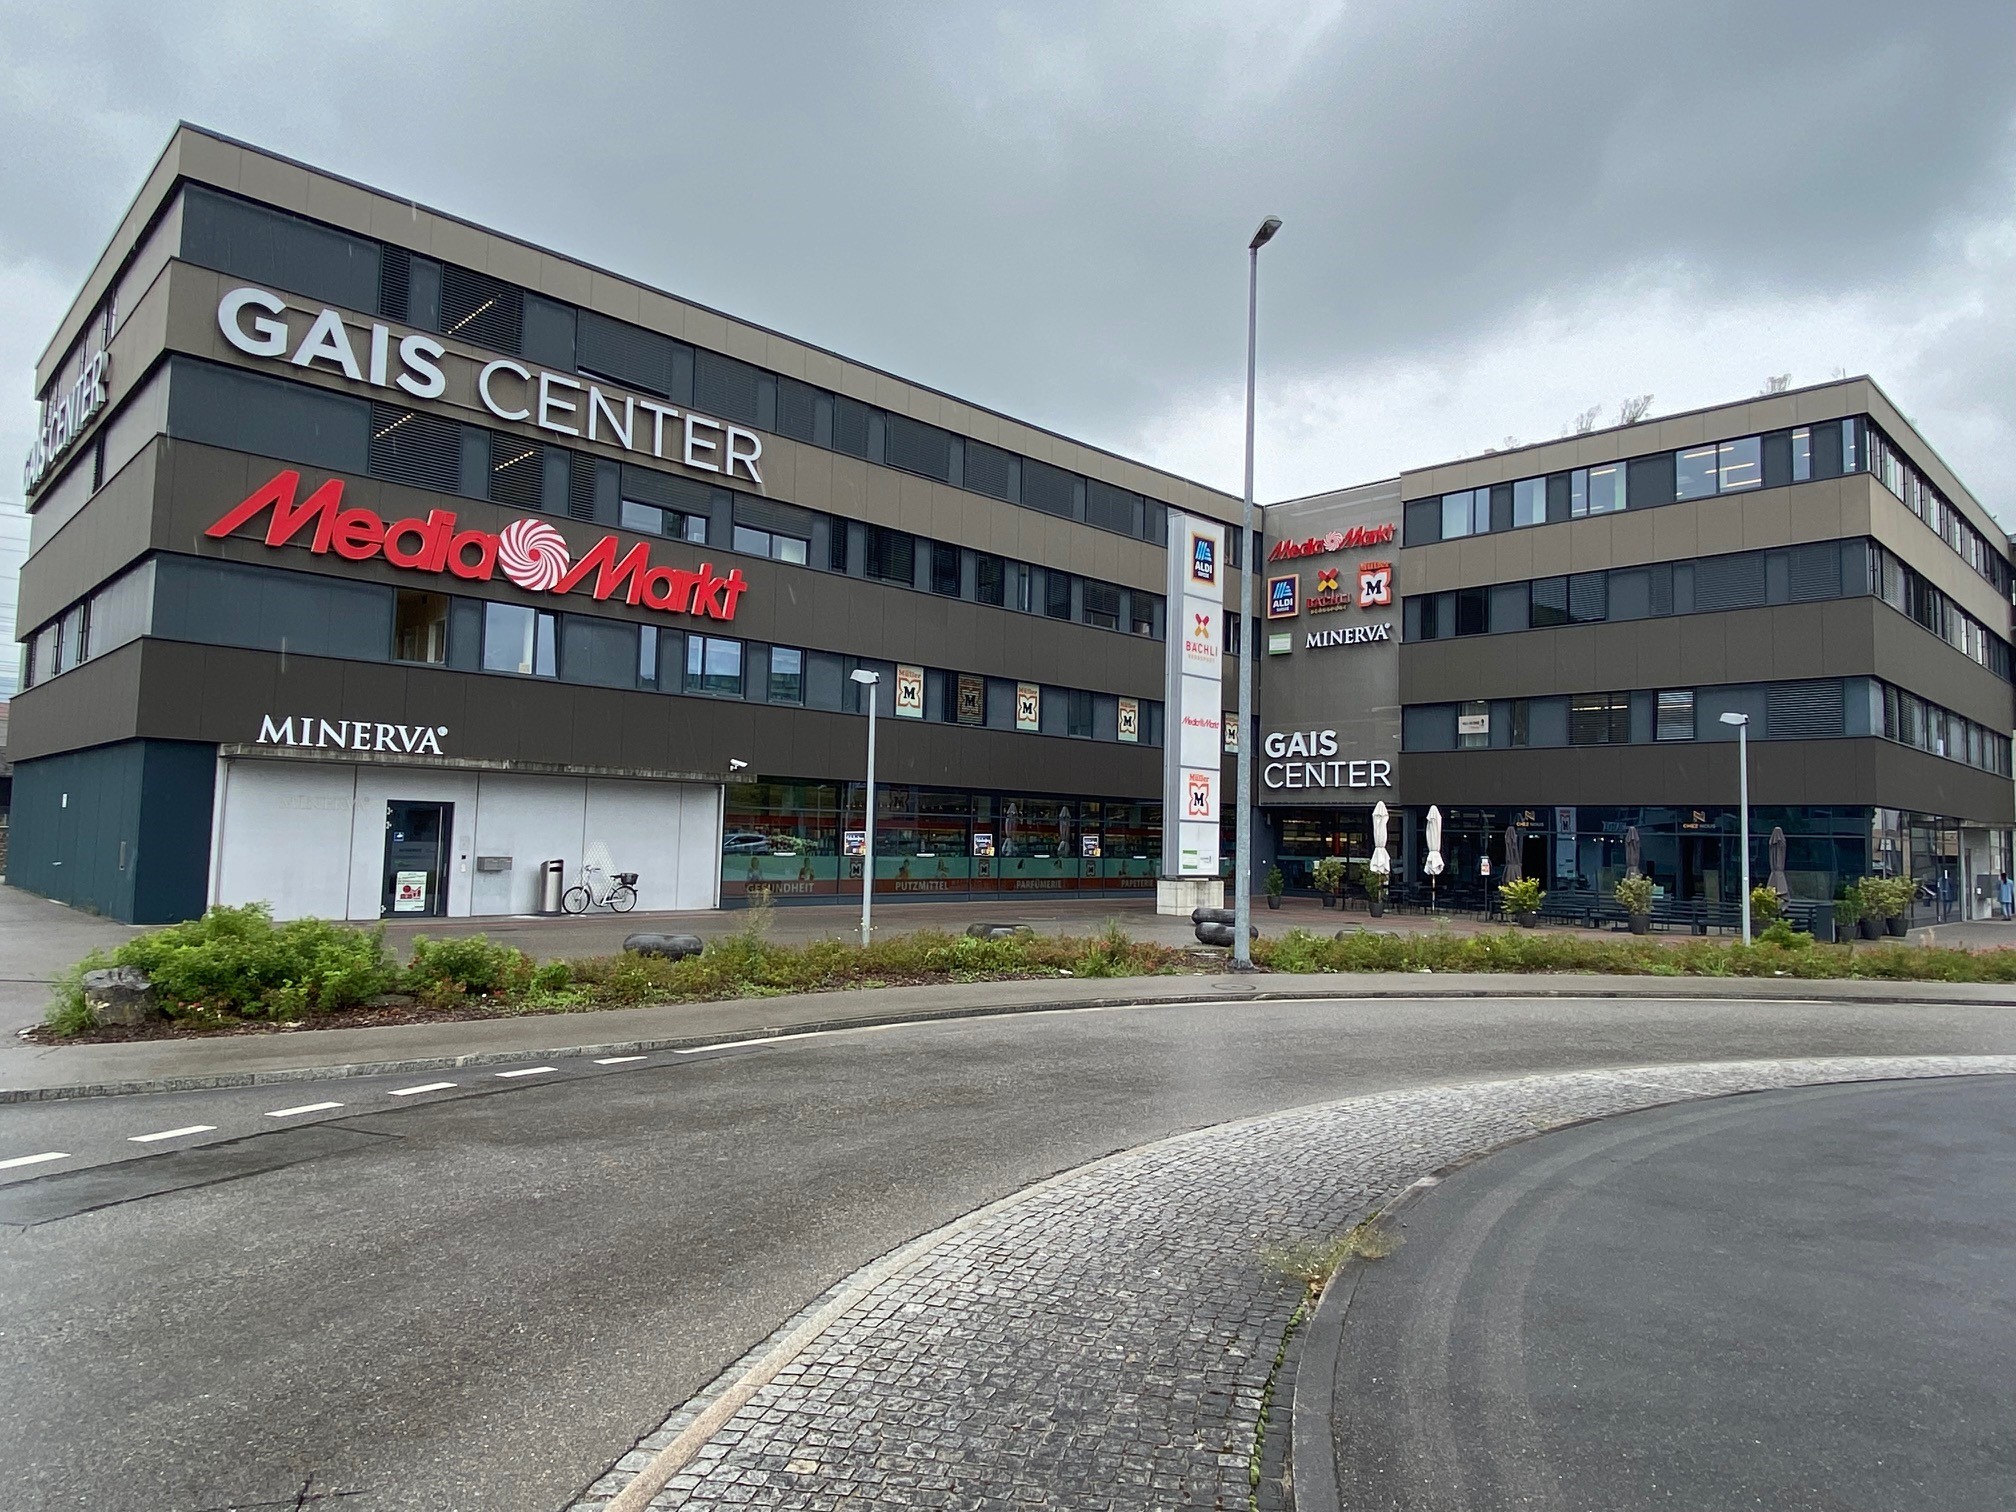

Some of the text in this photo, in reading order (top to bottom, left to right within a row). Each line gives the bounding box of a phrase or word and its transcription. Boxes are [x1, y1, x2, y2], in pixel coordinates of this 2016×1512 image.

[217, 286, 763, 484] GAIS CENTER
[49, 350, 109, 462] CENTER
[1195, 561, 1213, 573] ALDI
[1365, 579, 1382, 596] M
[1272, 598, 1293, 608] ALDI
[903, 686, 916, 699] M
[1022, 702, 1033, 714] M
[1123, 715, 1132, 727] M
[1264, 730, 1338, 758] GAIS
[1189, 773, 1209, 783] Müller
[1264, 759, 1391, 788] CENTER
[1194, 792, 1204, 807] M
[746, 882, 815, 894] GESUNDHEIT
[895, 880, 949, 891] PUTZMITTEL
[1016, 878, 1062, 889] PARFÜMERIE
